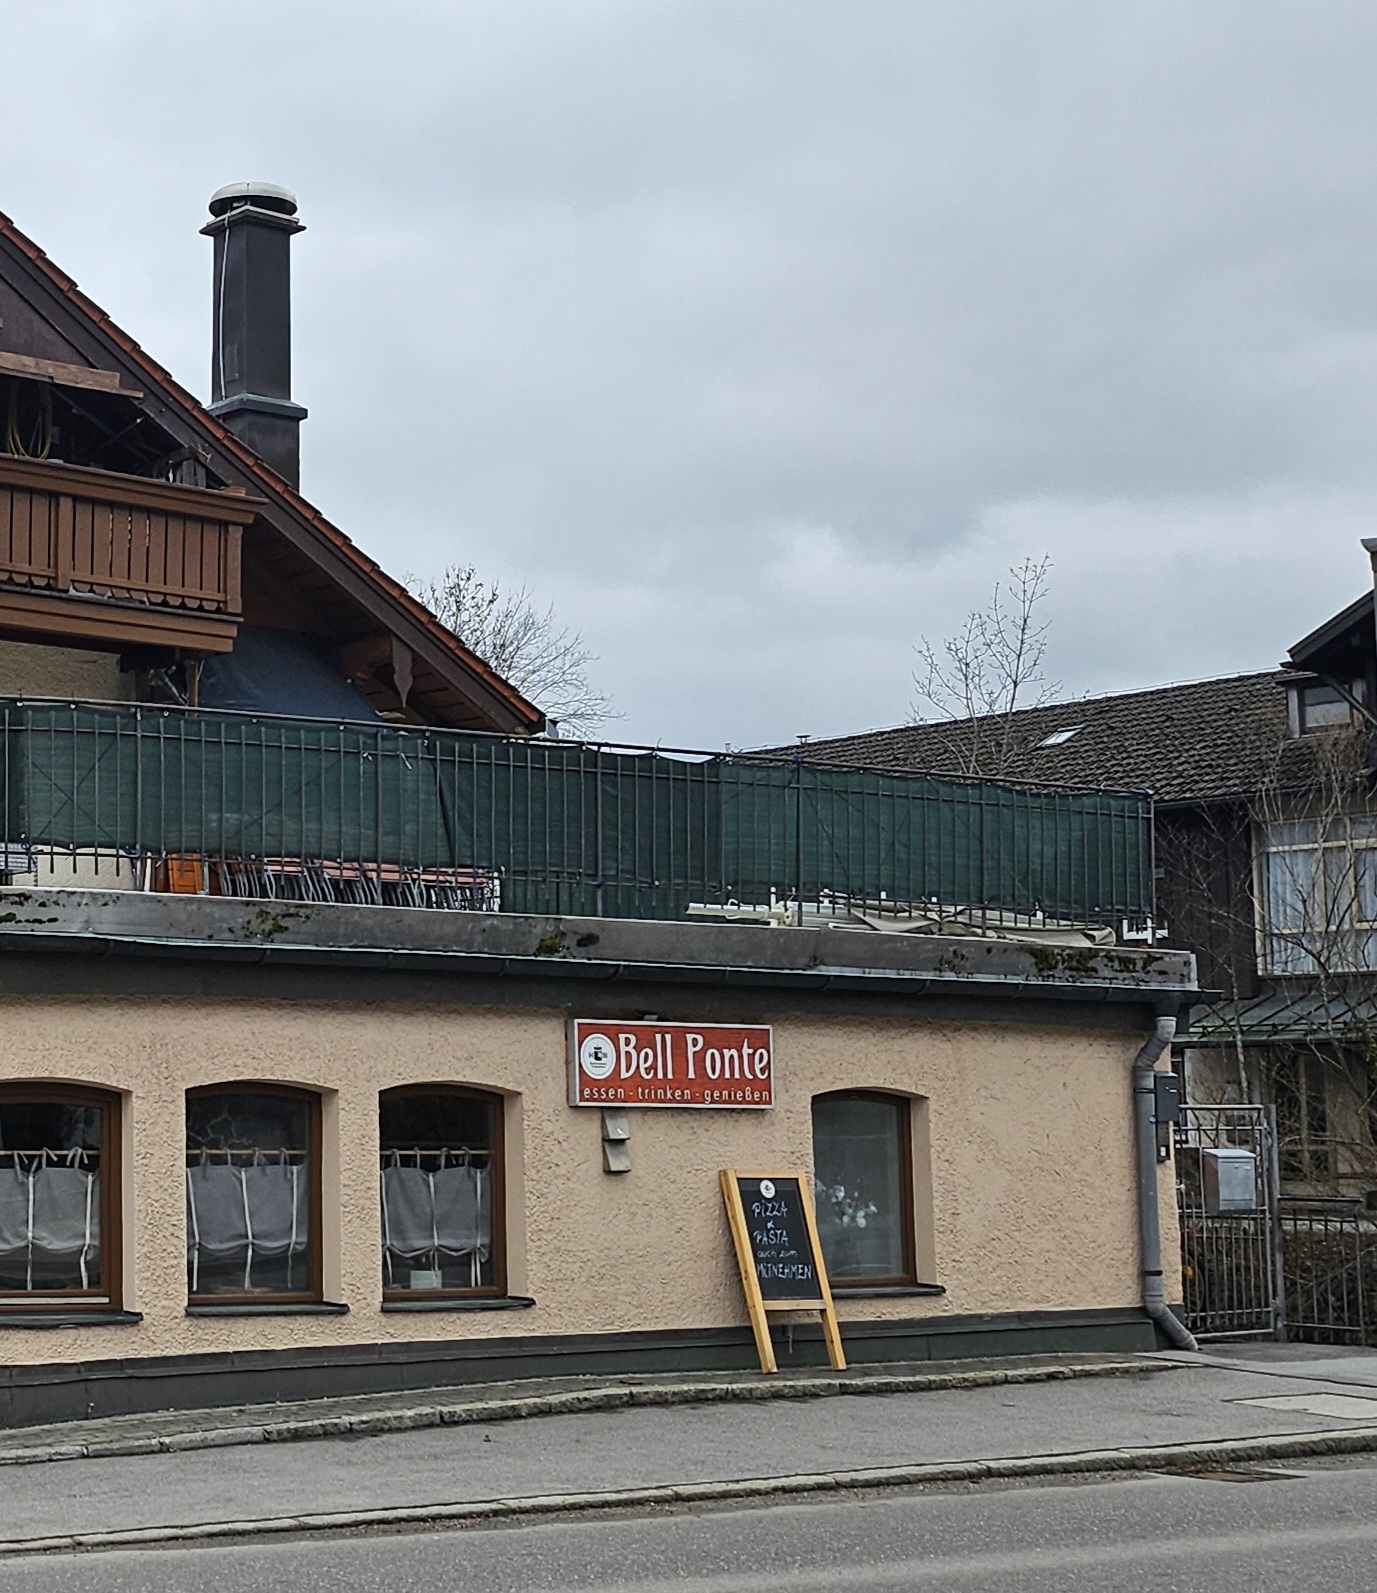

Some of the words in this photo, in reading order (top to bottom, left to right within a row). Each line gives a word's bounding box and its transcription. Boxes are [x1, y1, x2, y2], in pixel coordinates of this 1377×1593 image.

[617, 1033, 674, 1080] Bell
[686, 1033, 769, 1080] Ponte
[583, 1087, 625, 1099] essen
[637, 1085, 691, 1100] trinken
[704, 1087, 770, 1104] genießen
[753, 1229, 788, 1246] PASTA
[757, 1249, 777, 1258] auch
[779, 1250, 798, 1258] zum
